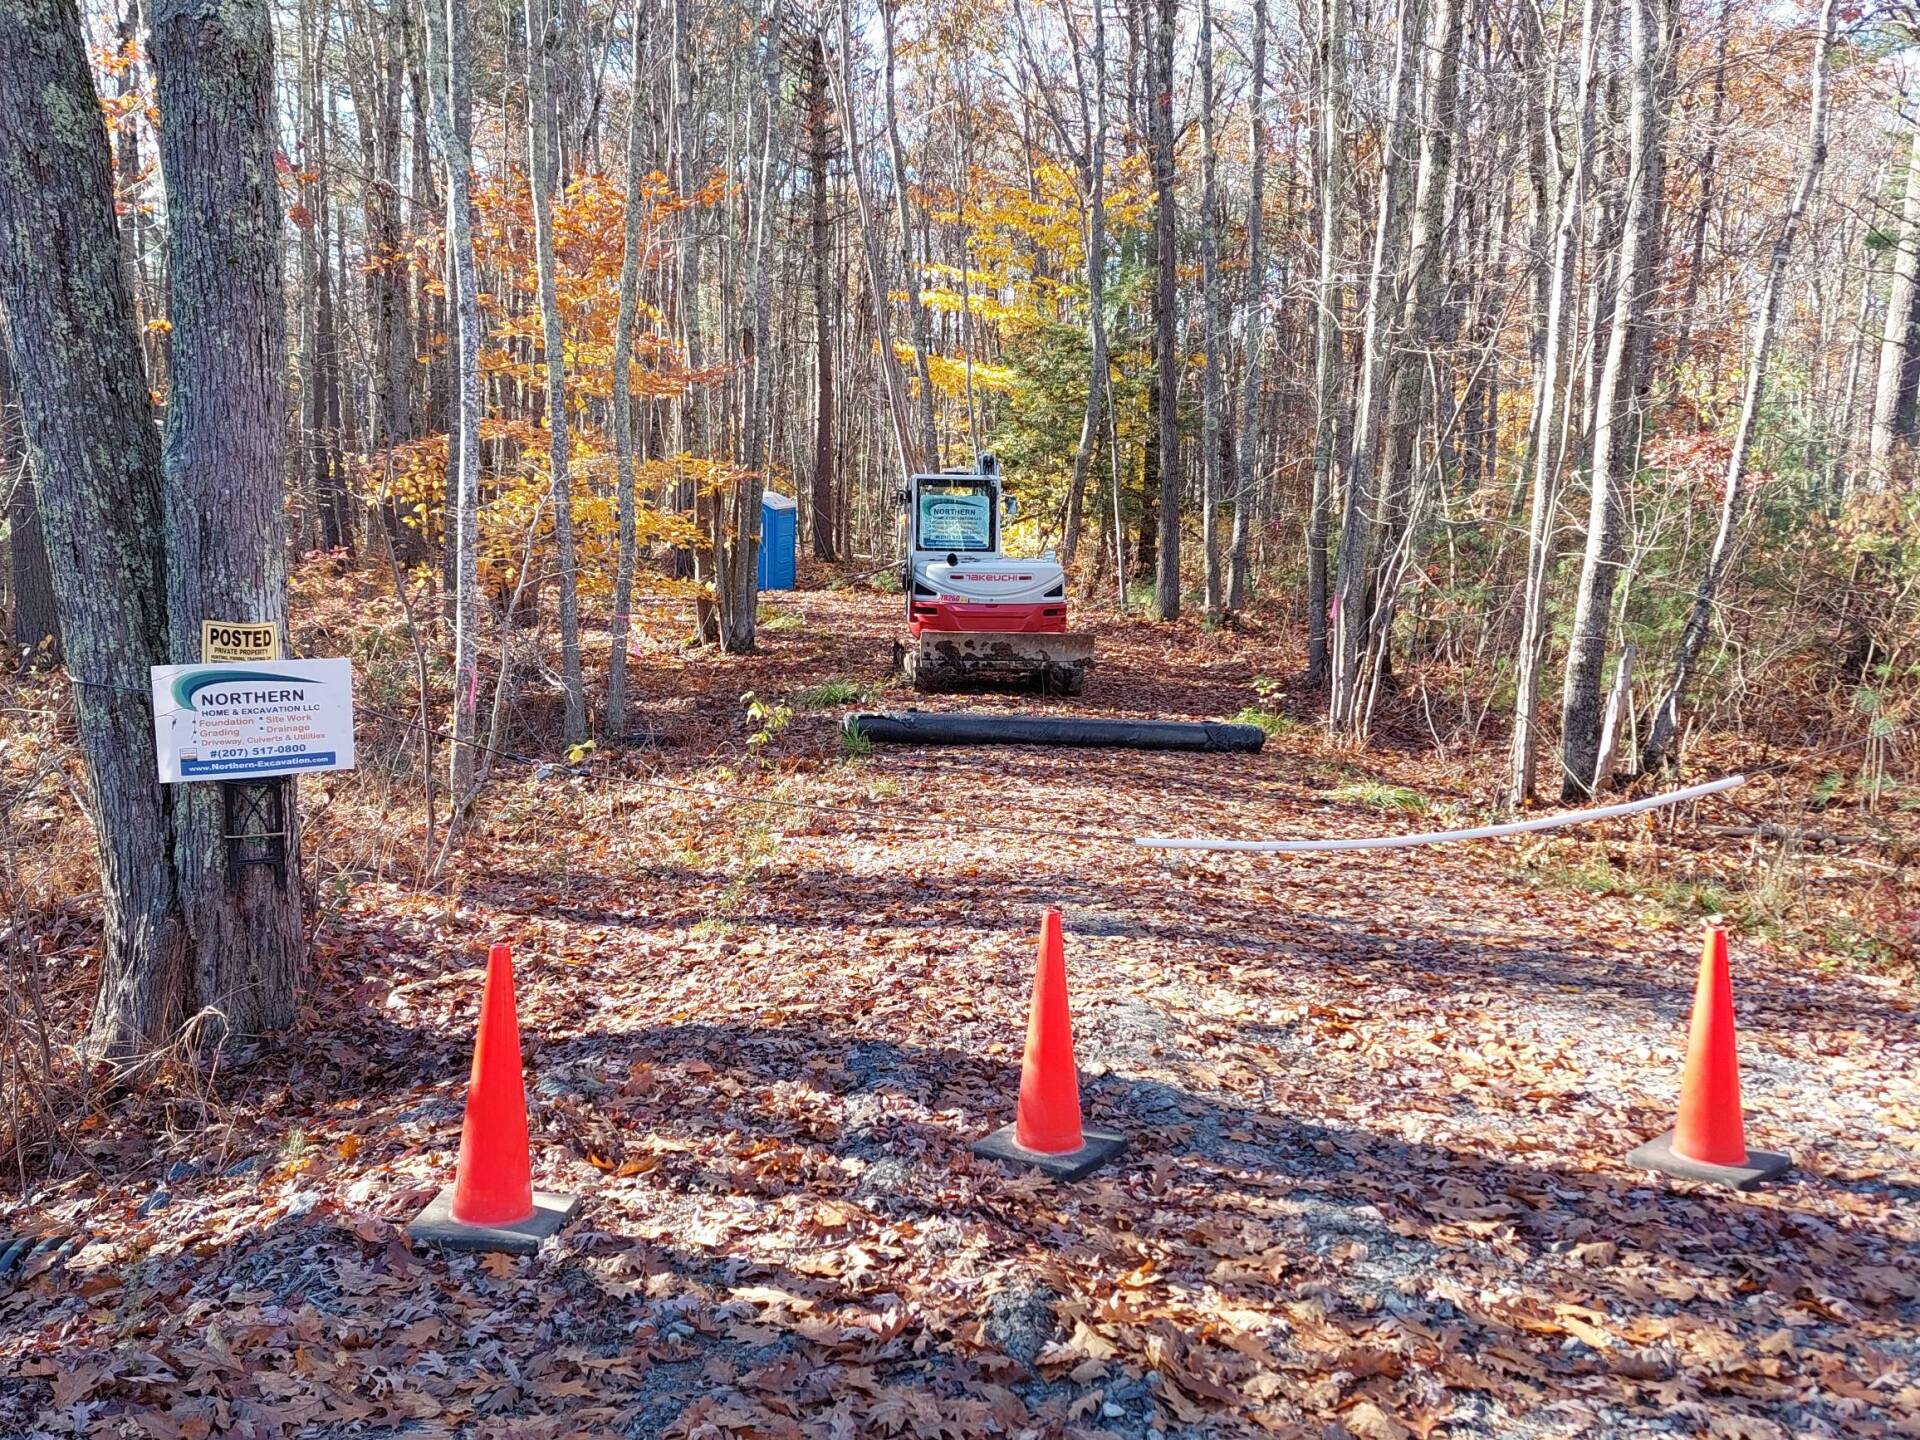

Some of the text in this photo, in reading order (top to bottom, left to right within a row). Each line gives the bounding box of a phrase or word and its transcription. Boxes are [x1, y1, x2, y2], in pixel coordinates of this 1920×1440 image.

[934, 508, 976, 516] NORTHERN
[210, 628, 272, 648] POSTED
[214, 647, 268, 656] PRIVATE PROPERTY
[201, 689, 305, 706] NORTHERN
[202, 709, 230, 717] HOME
[241, 705, 301, 715] EXCAVATION
[199, 718, 254, 727] Foundation
[266, 714, 312, 724] Site Work
[200, 729, 240, 738] Grading
[266, 724, 310, 733] Drainage
[247, 734, 283, 744] Culverts
[294, 732, 325, 741] Utilities
[210, 748, 248, 759] #(207)
[252, 744, 306, 756] 517-0800
[188, 756, 328, 772] www.Northern-Excavation.com
